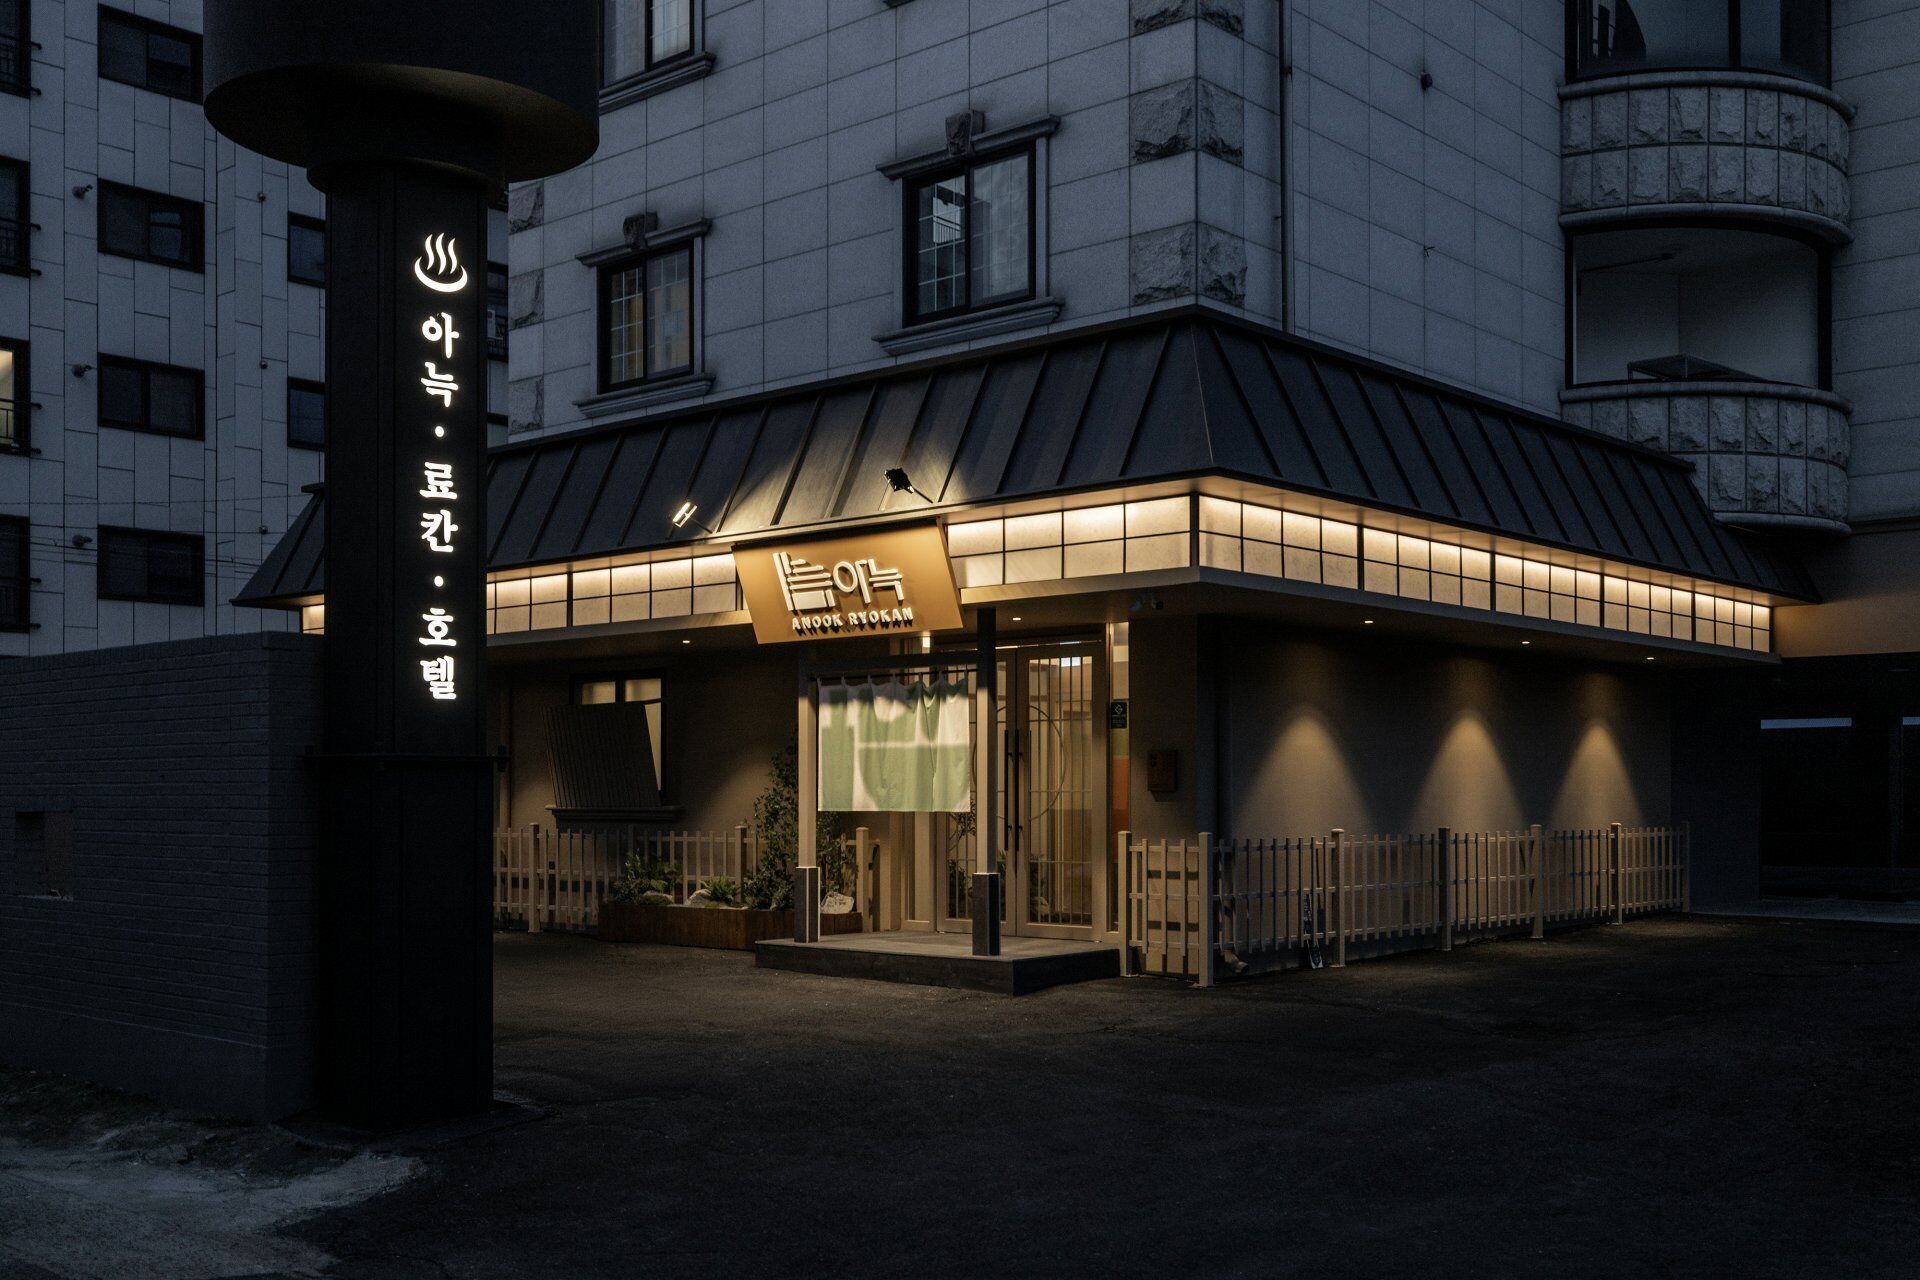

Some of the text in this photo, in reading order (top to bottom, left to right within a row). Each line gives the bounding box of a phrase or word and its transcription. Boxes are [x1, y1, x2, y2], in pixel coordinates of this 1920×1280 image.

[419, 311, 460, 700] 아늑 료칸 호텔
[792, 607, 914, 630] ANOOK RYOKAN
